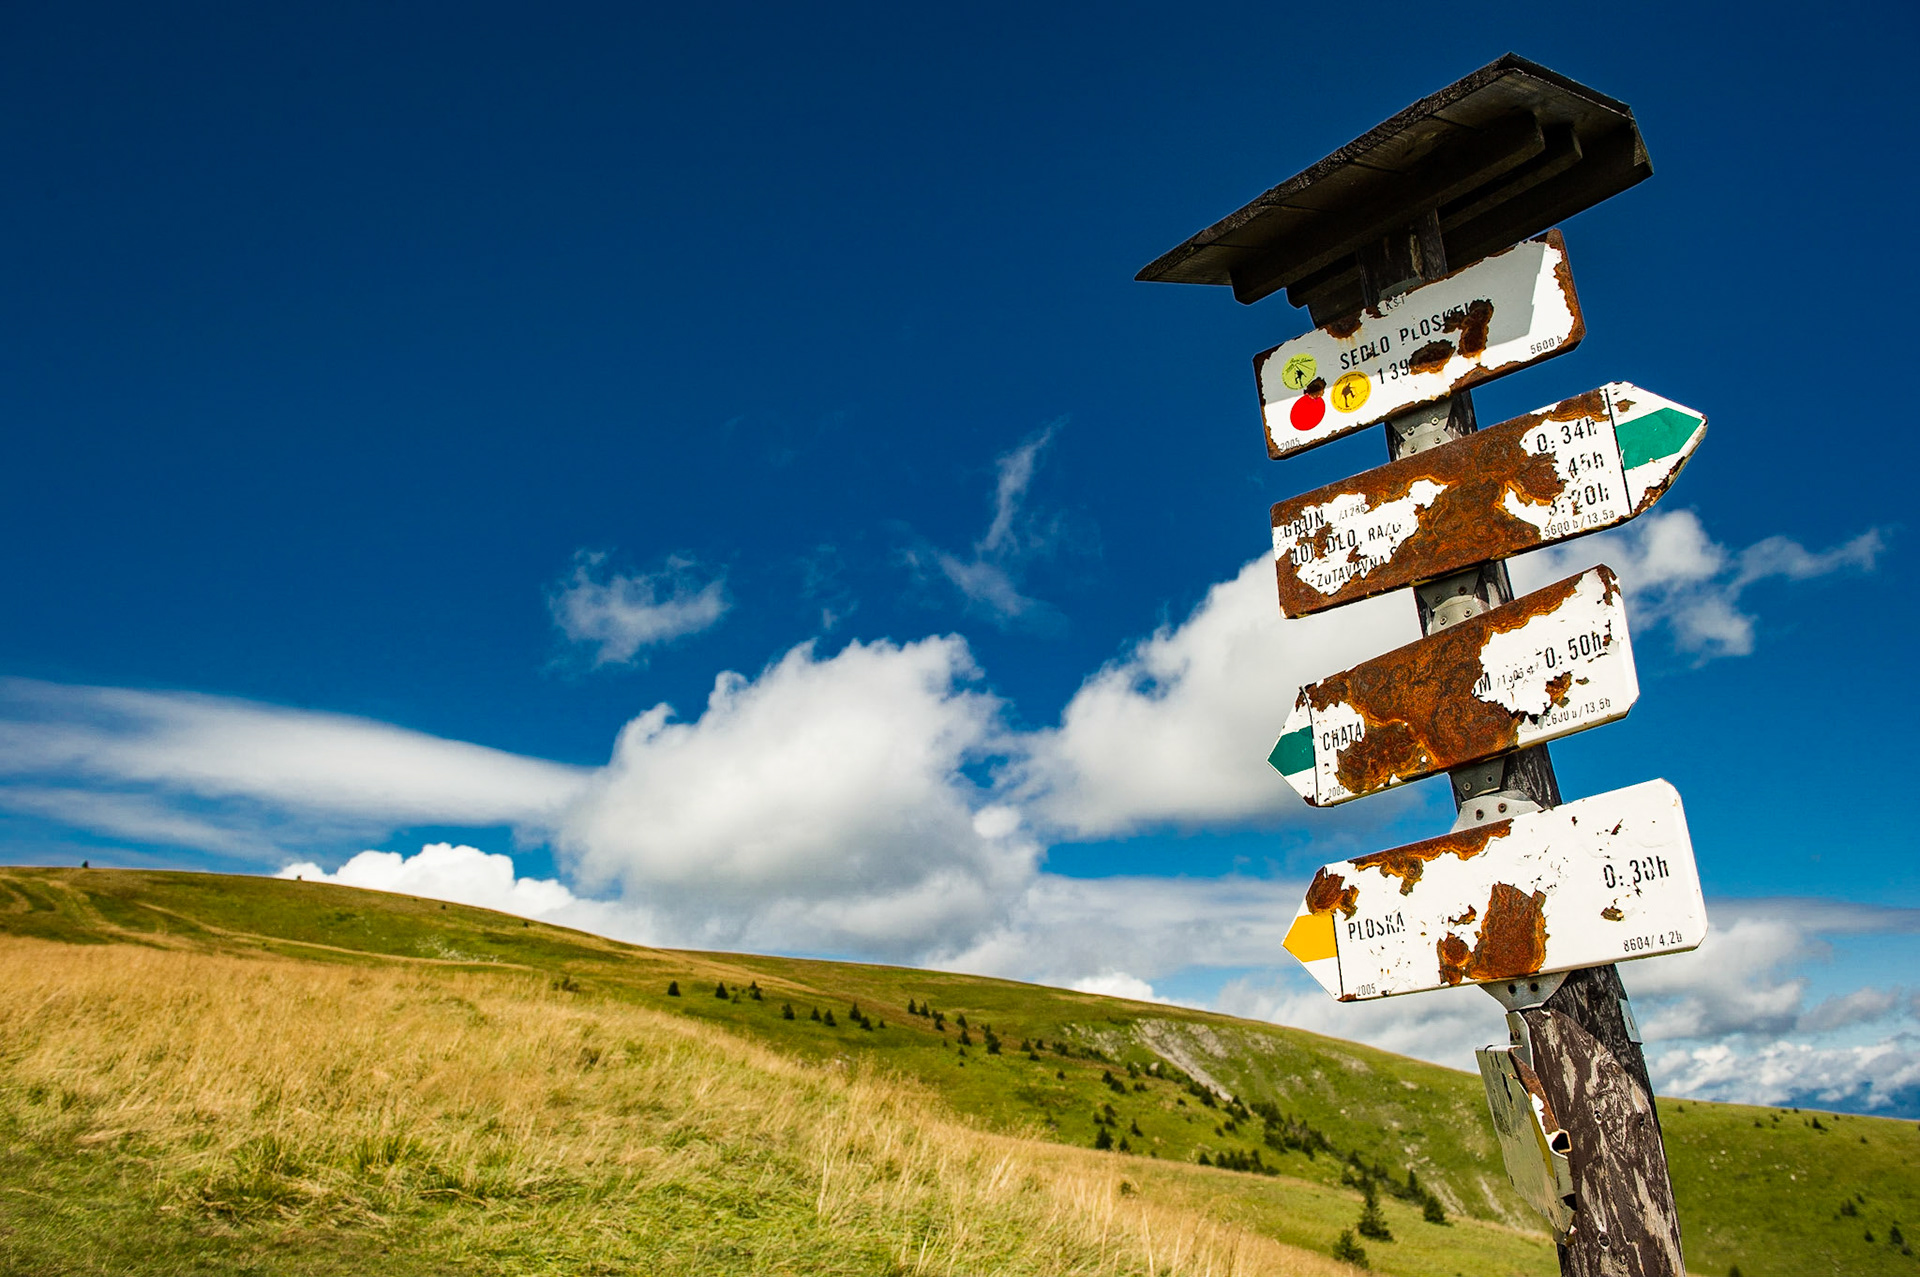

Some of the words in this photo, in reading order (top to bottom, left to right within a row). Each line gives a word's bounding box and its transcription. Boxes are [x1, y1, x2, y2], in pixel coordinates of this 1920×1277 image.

[1340, 336, 1390, 370] SEDLO
[1530, 337, 1555, 355] 5600
[1545, 631, 1602, 669] 0:50h
[1323, 722, 1363, 751] CHATA
[1328, 785, 1346, 798] 2005
[1603, 855, 1669, 889] 0:30h
[1356, 983, 1376, 997] 2005
